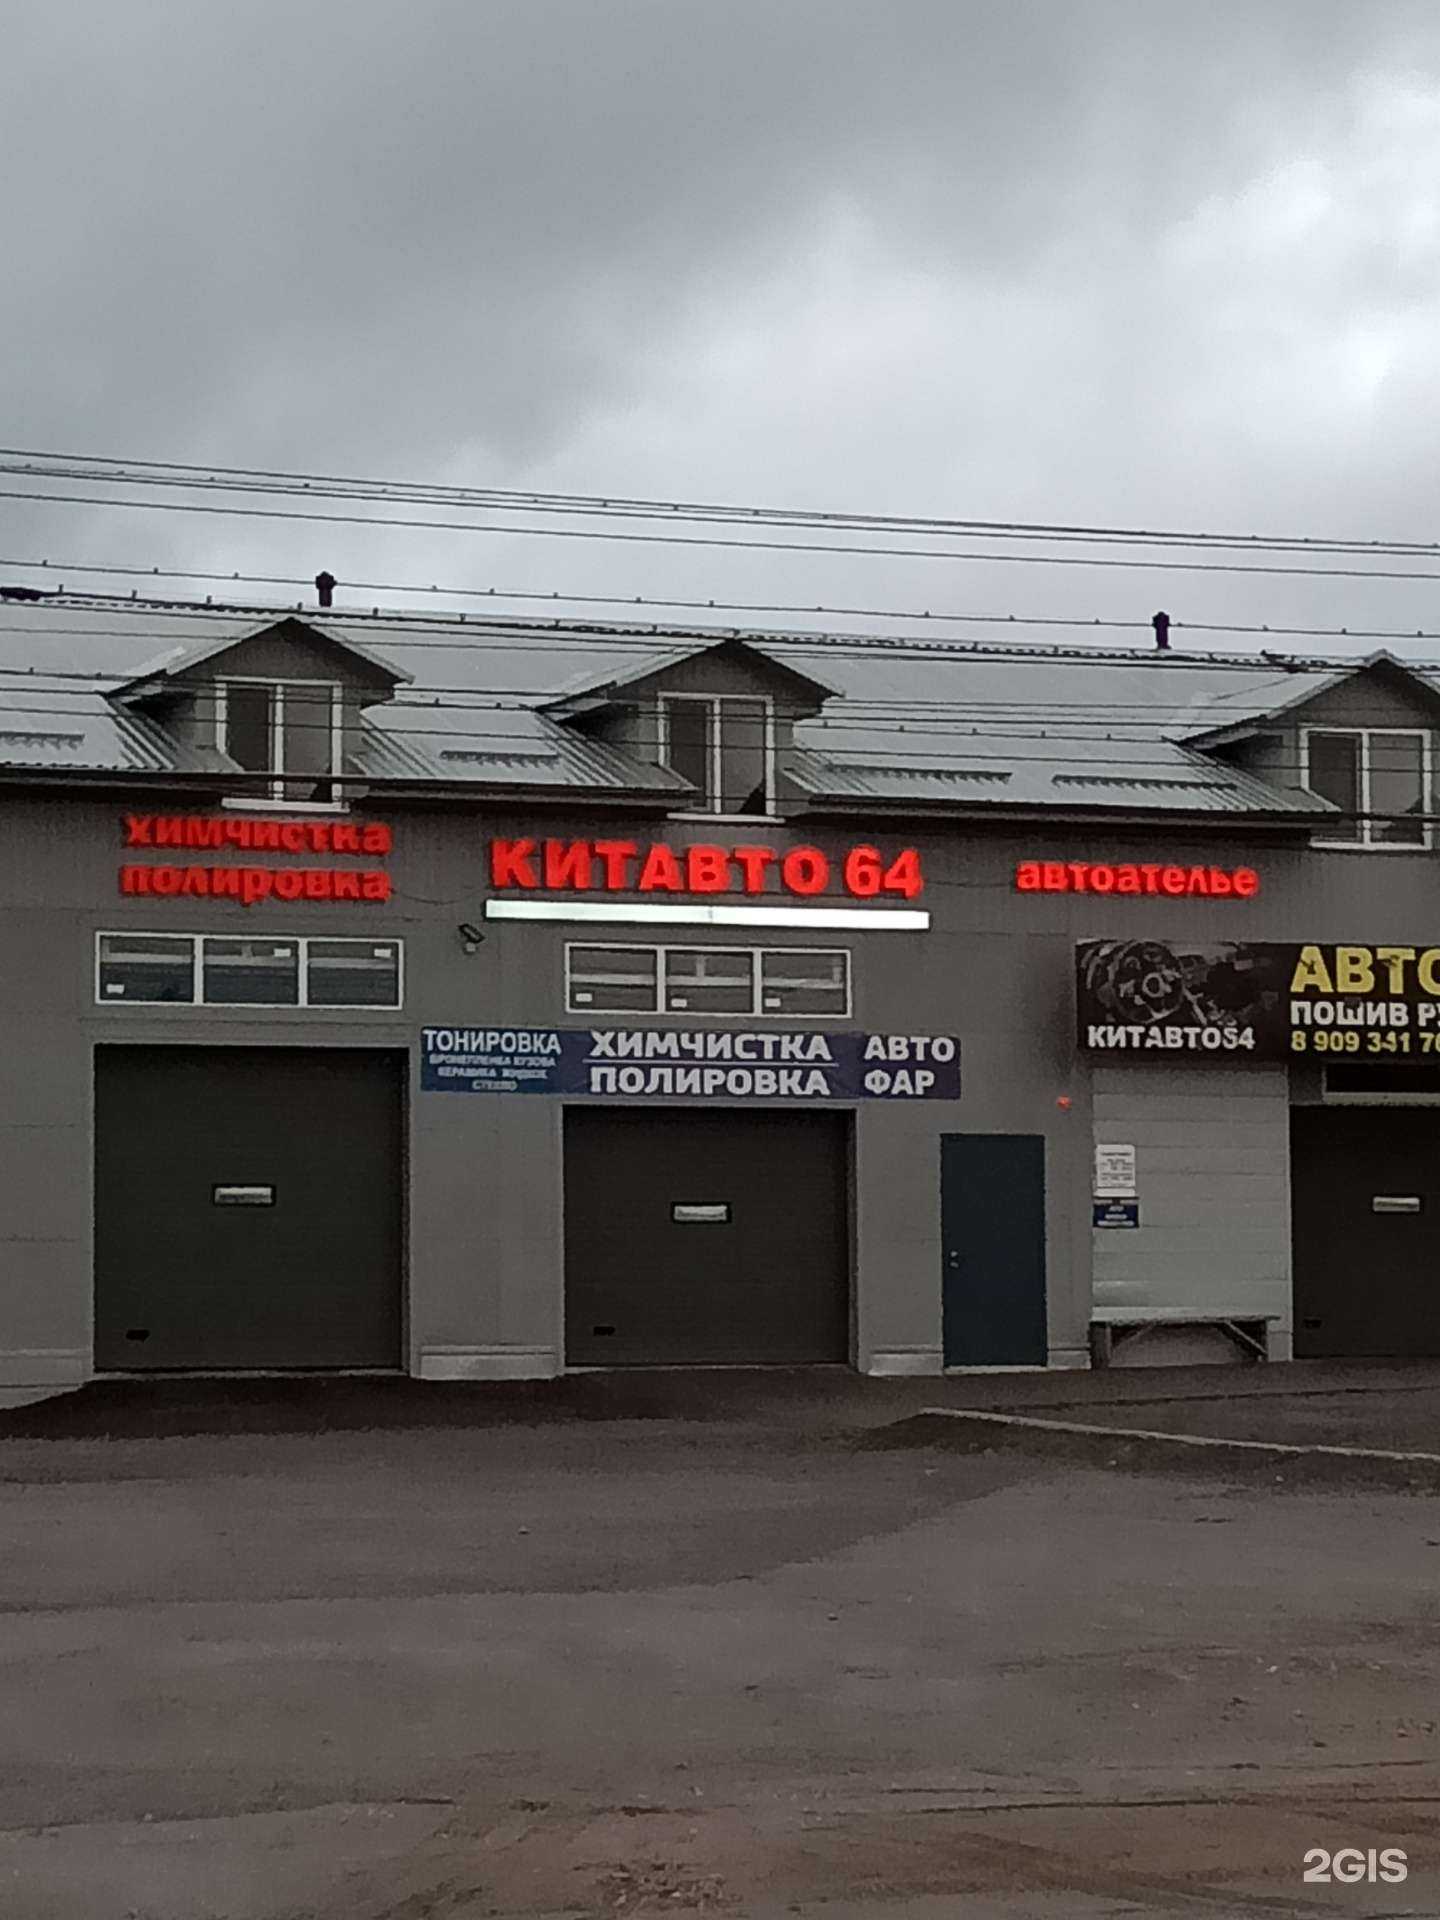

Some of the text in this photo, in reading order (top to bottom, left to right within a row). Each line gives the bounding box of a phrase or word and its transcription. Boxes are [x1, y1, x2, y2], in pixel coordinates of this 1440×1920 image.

[125, 815, 392, 855] химчистка
[490, 837, 924, 899] КИТАВТО 64
[1014, 860, 1260, 898] автоателье
[121, 864, 392, 905] полировка
[1290, 1000, 1440, 1028] ПОШИВ Р
[422, 1029, 562, 1055] ТОНИРОВКА
[589, 1030, 833, 1061] ХИМЧИСТКА
[864, 1035, 956, 1062] АВТО
[1291, 1030, 1307, 1051] 8
[1313, 1030, 1360, 1052] 909
[590, 1066, 831, 1096] ПОЛИРОВКА
[864, 1069, 935, 1095] ФАР
